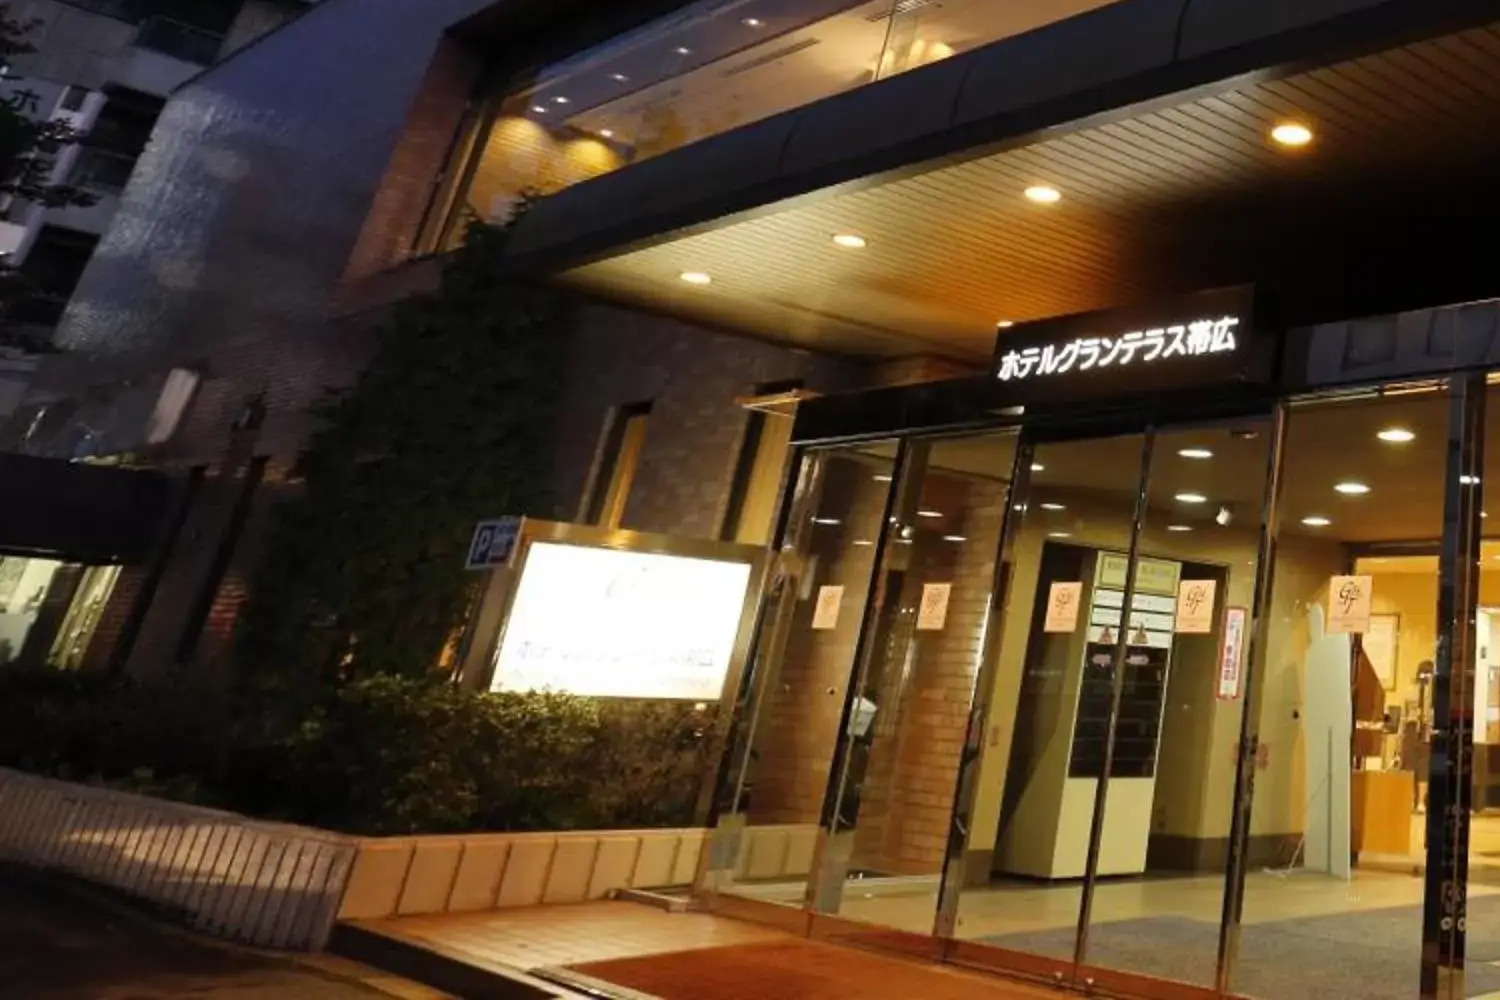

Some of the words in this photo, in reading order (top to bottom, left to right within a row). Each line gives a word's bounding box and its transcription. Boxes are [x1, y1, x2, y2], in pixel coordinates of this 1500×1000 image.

[997, 315, 1239, 381] ホテルグランテラス帯広
